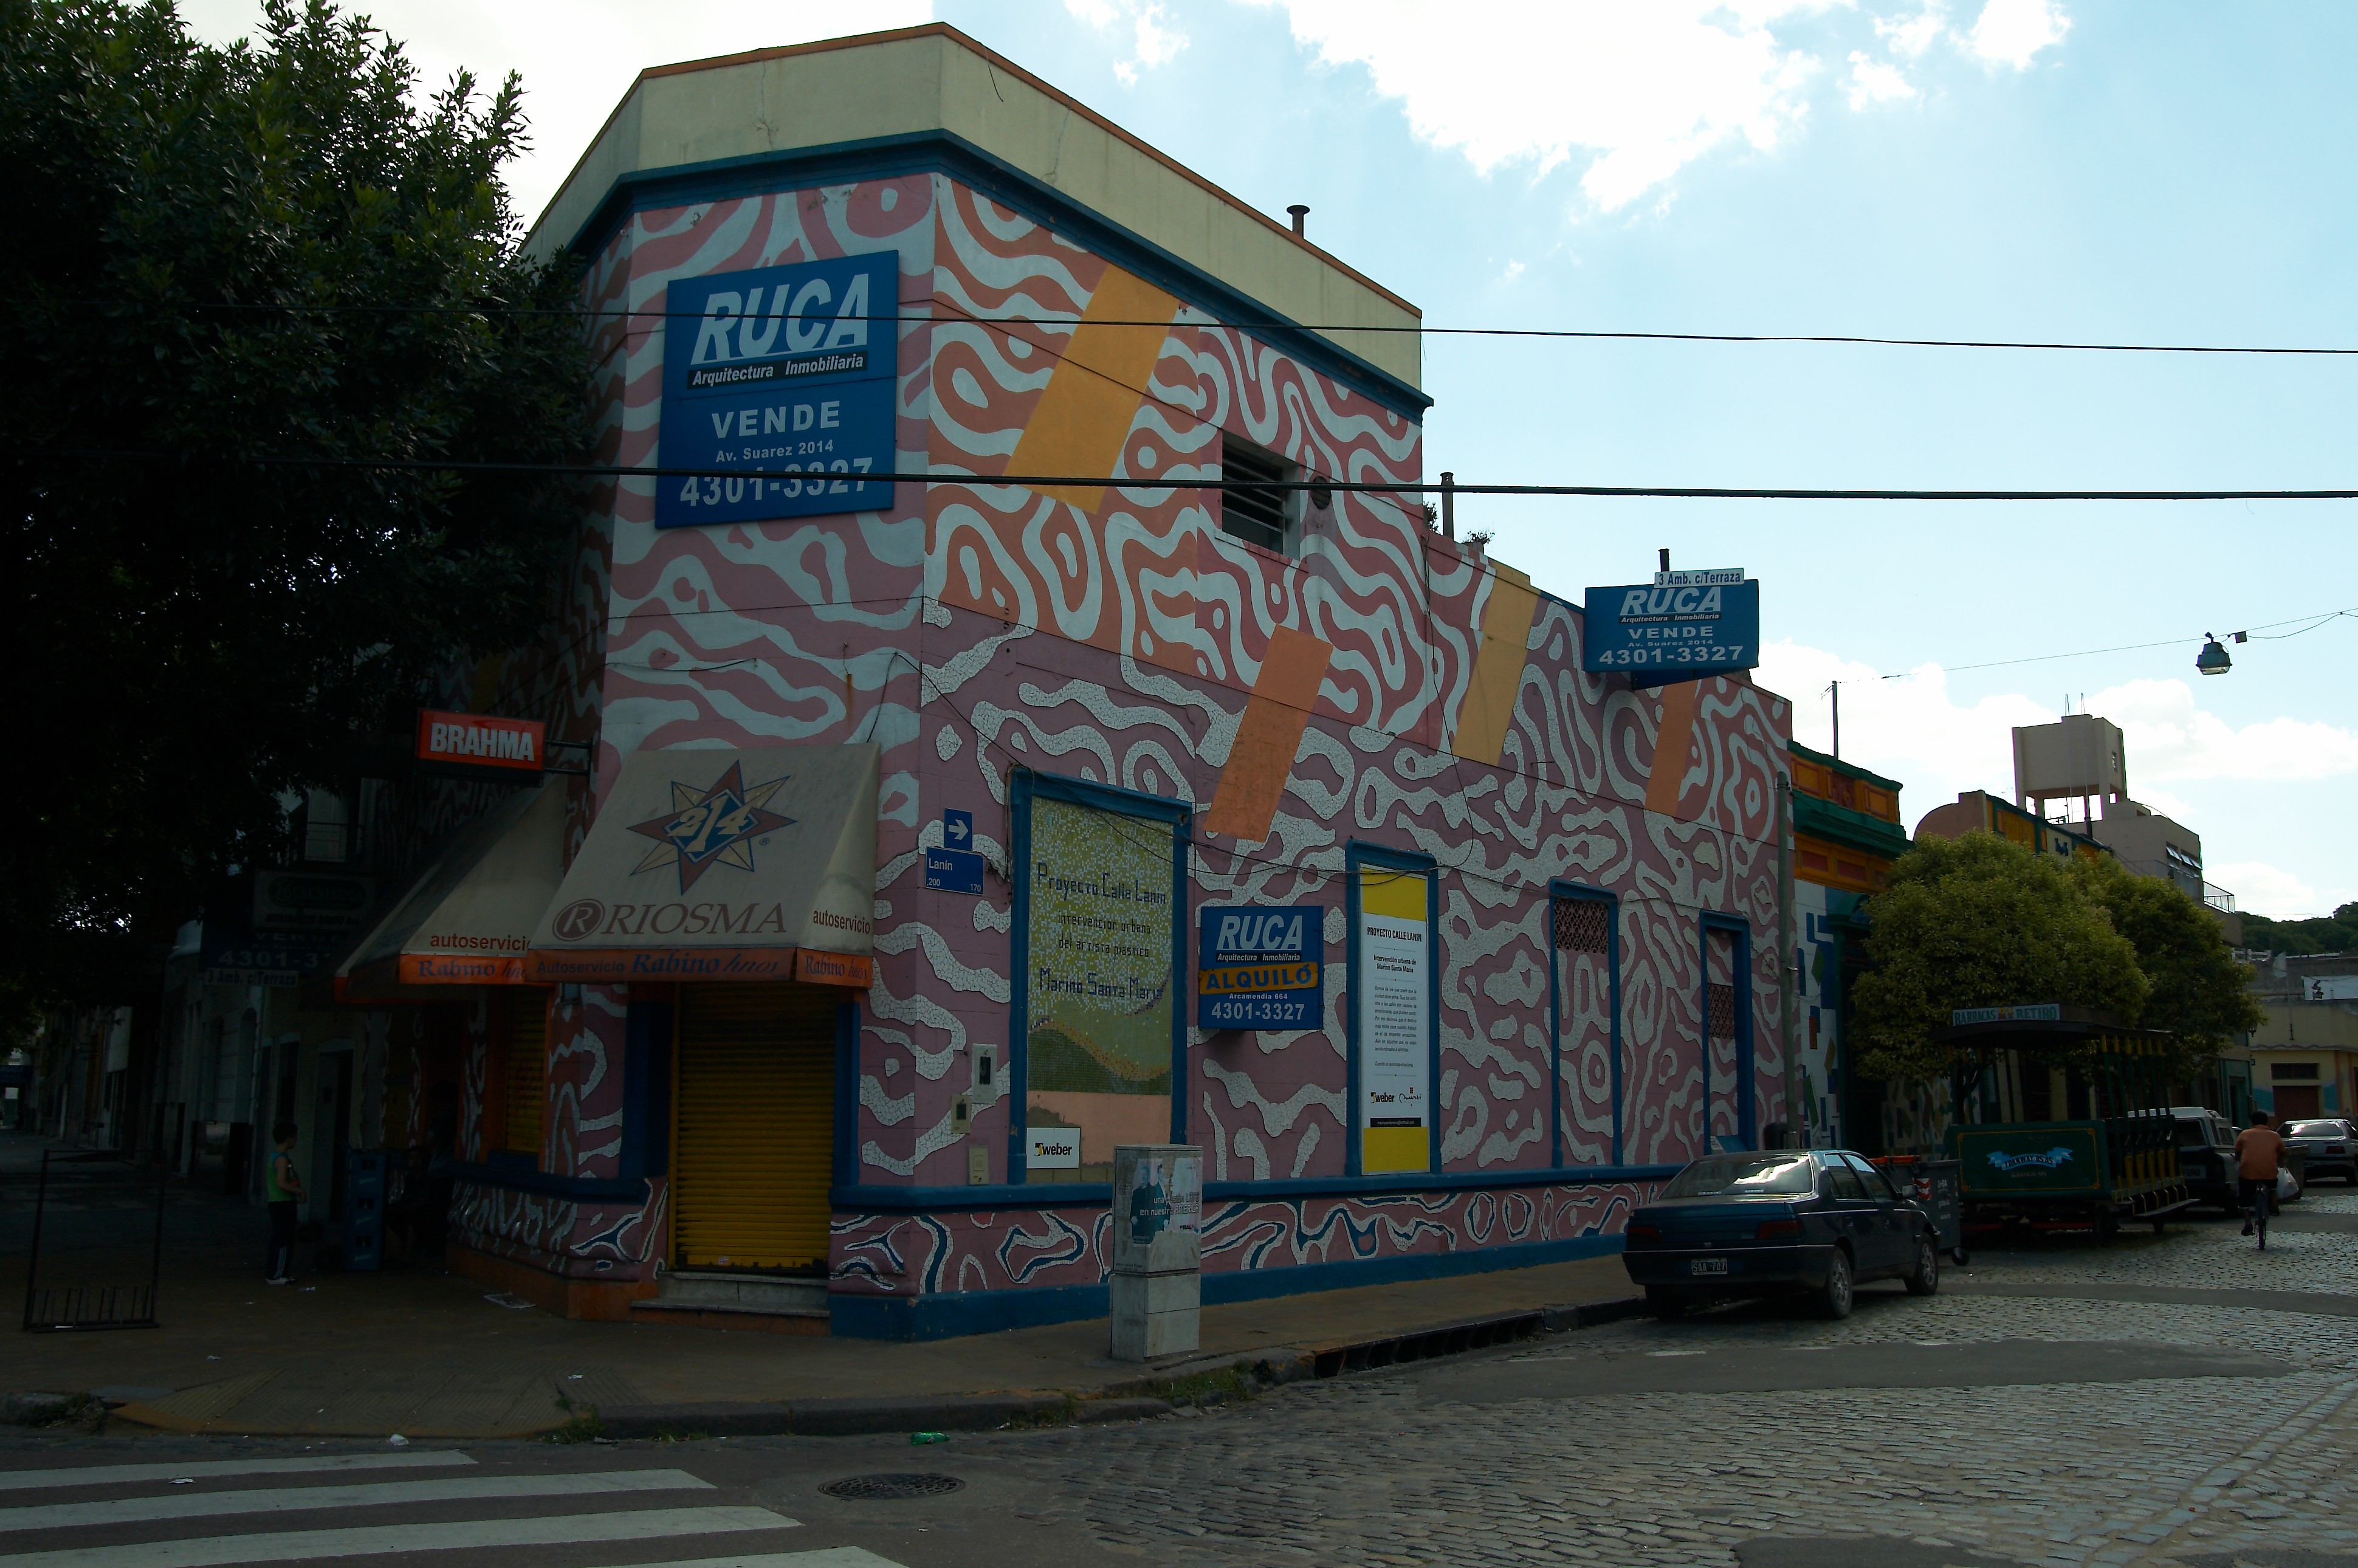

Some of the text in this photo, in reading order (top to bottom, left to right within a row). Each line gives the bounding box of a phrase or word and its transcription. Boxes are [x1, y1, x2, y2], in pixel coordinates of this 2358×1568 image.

[690, 273, 869, 365] RUCA
[692, 353, 864, 387] Arquitectura Inmobiliaria
[711, 400, 840, 439] VENDE
[716, 439, 834, 462] Av. Suarez 2014
[679, 457, 873, 507] 4301-3327
[1659, 572, 1741, 585] 3 Amb. c/Terraza
[1620, 586, 1721, 616] RUCA
[1621, 615, 1668, 624] Arquitectura
[1628, 626, 1714, 639] VENDE
[1599, 645, 1743, 665] 4301-3327
[430, 721, 535, 762] BRAHMA
[929, 858, 953, 872] Lanín
[1102, 872, 1131, 901] Calle
[601, 903, 787, 935] RIOSMA
[813, 910, 871, 934] autoservicio
[1121, 918, 1151, 934] urbana
[430, 934, 531, 951] autoservici
[1059, 932, 1072, 949] del
[1076, 940, 1110, 954] artista
[1216, 915, 1303, 951] RUCA
[1367, 926, 1392, 938] PROYECTO
[1392, 930, 1406, 940] CALLE
[418, 958, 496, 977] Rabino
[537, 951, 779, 974] Autoservicio Rabino hnos
[805, 955, 845, 977] Rabino
[1217, 953, 1258, 962] Arquitectura
[207, 971, 296, 985] 3 Amb. c/Terraza
[1040, 968, 1083, 994] Marino
[1088, 972, 1125, 997] Santa
[1206, 964, 1311, 990] ALQUILÓ
[1211, 1002, 1305, 1020] 4301-3327
[1375, 1092, 1395, 1103] weber
[1042, 1143, 1073, 1155] weber
